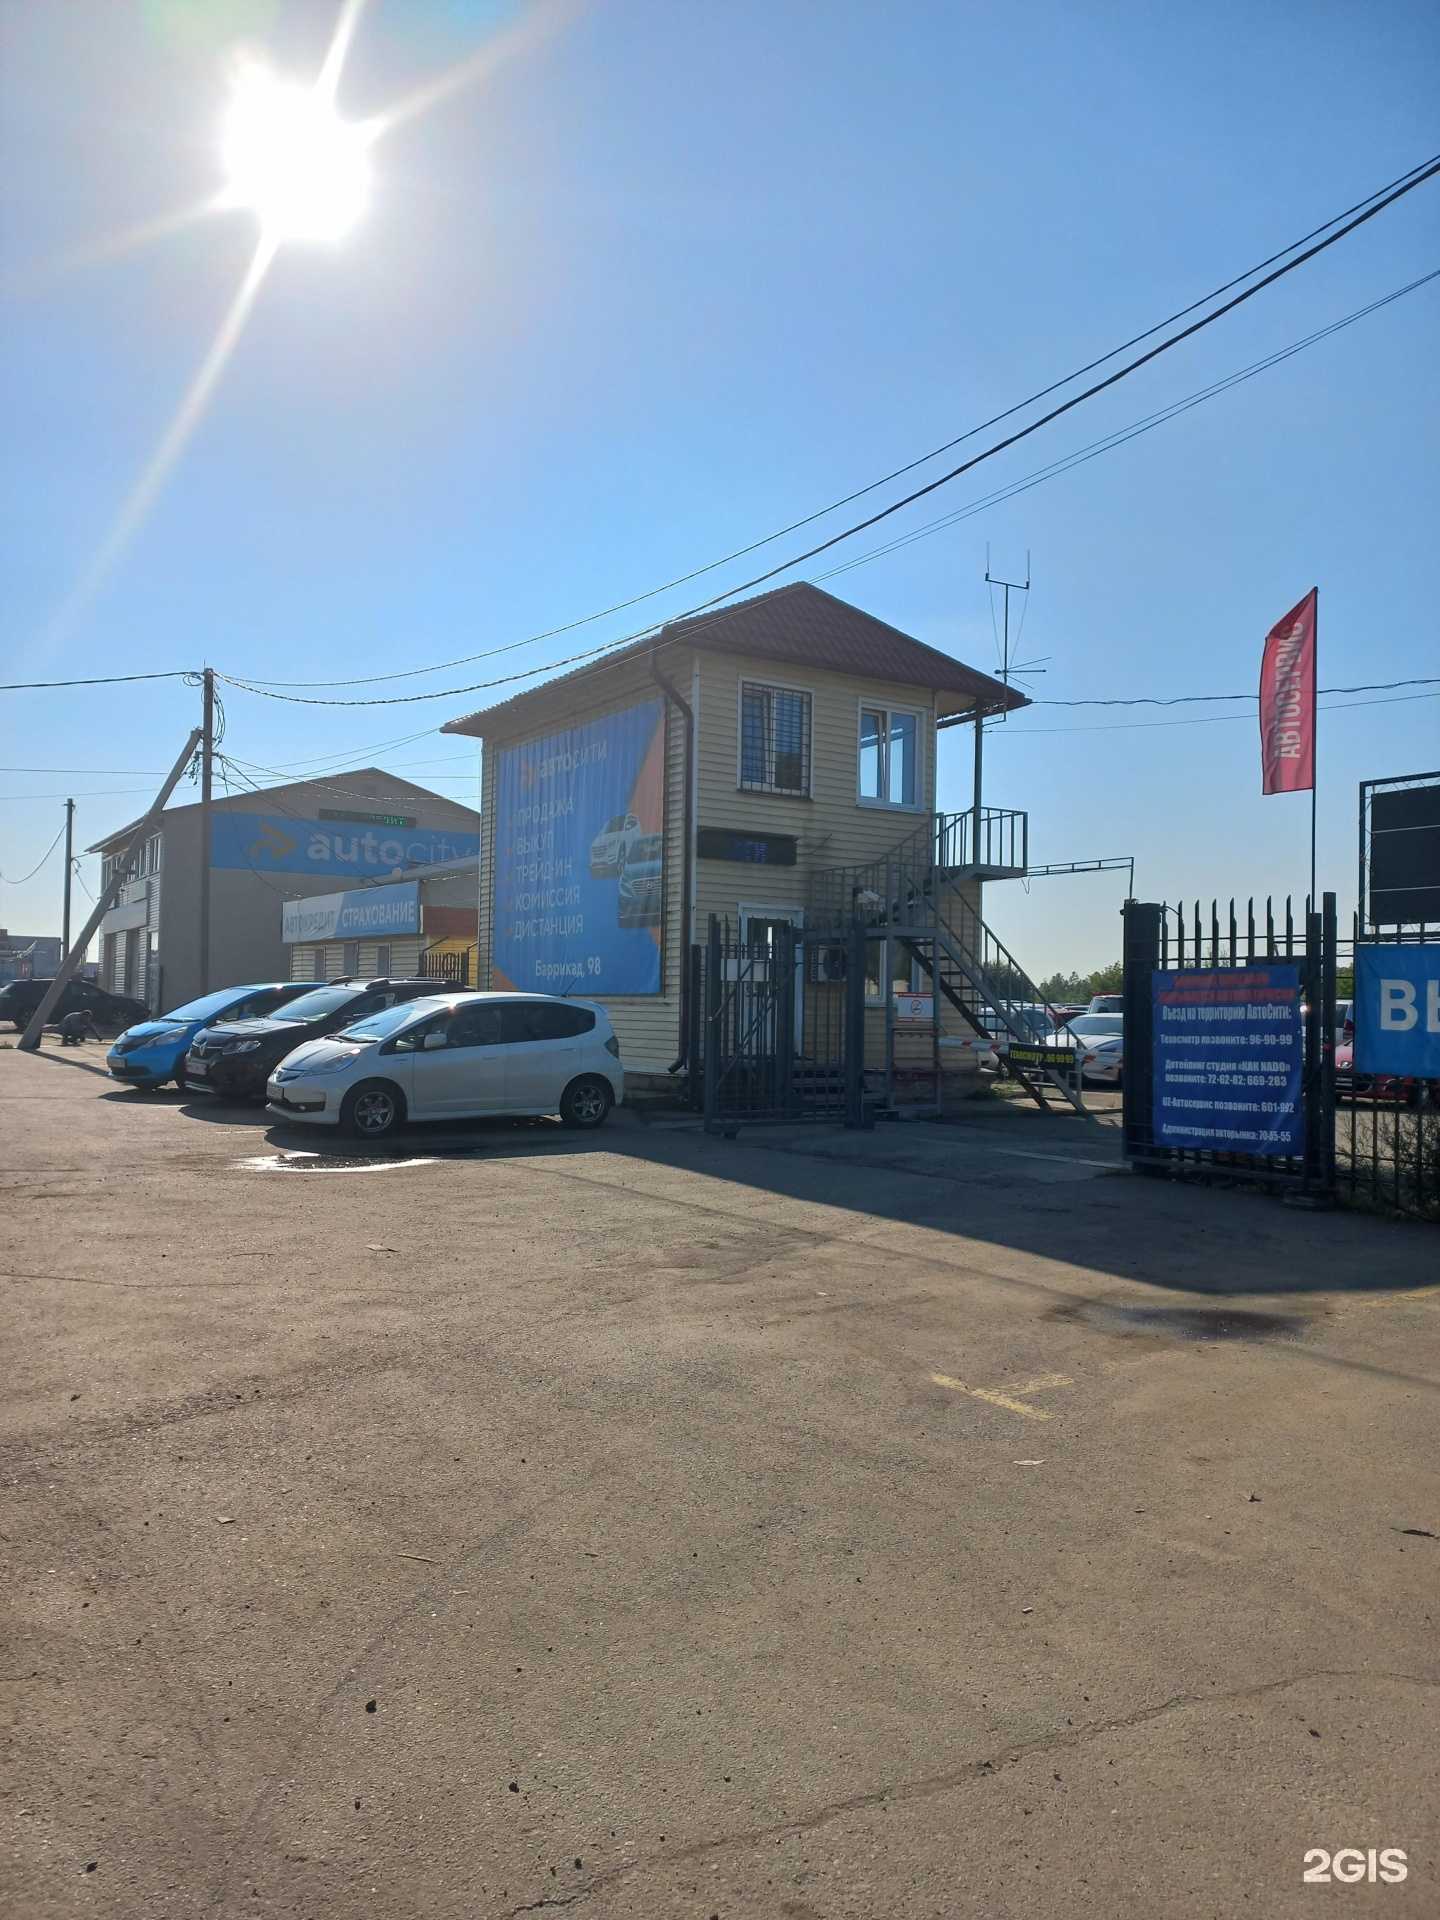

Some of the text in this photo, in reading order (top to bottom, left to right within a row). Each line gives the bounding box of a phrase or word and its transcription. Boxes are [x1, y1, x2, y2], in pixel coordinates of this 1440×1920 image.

[516, 795, 575, 826] ПРОДАЖА
[516, 830, 554, 856] ВЫКУП
[514, 885, 581, 912] КОМИССИЯ
[342, 900, 415, 929] СТРАХОВАНИЕ
[514, 914, 584, 942] ДИСТАНЦИЯ
[587, 956, 601, 976] 98
